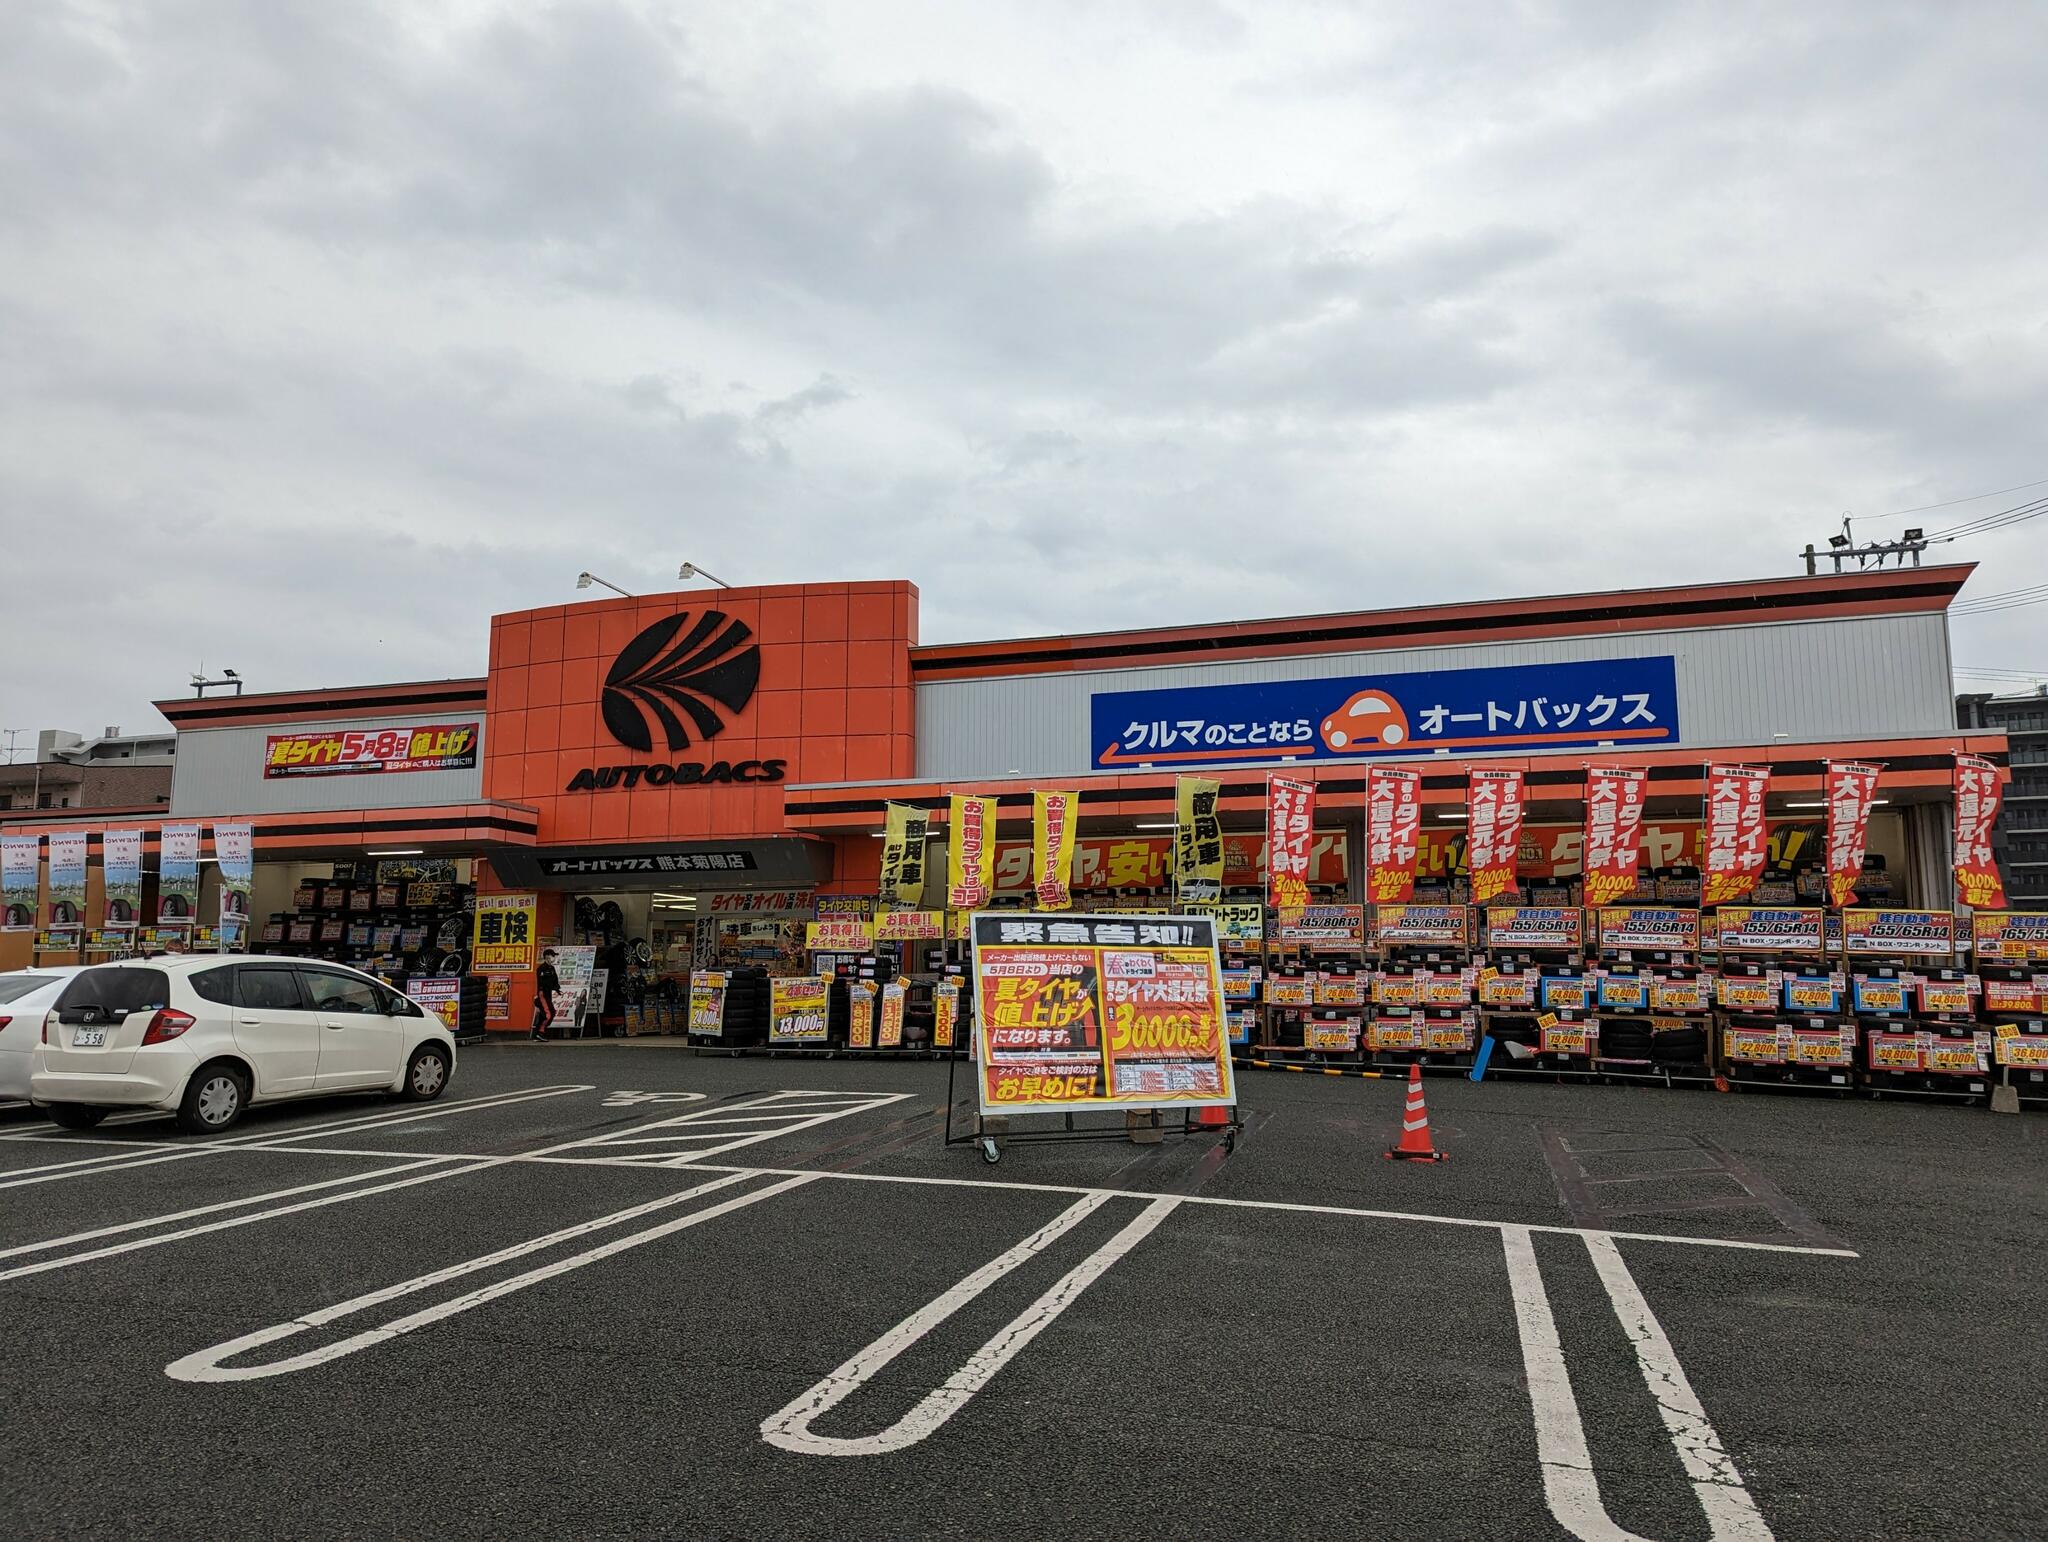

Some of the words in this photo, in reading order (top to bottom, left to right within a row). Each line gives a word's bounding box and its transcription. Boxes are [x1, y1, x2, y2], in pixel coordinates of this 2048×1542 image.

[1123, 720, 1313, 750] クルマのことなら
[1419, 692, 1656, 735] オートバックス
[271, 740, 341, 764] 夏タイヤ
[566, 760, 787, 791] AUTOBACS
[1193, 792, 1221, 865] 商用車
[552, 858, 653, 872] オートバックス
[656, 853, 746, 870] 熊本菊陽店
[900, 820, 926, 885] 商用車
[479, 911, 529, 944] 車検
[1299, 917, 1360, 927] 145/80R13
[1399, 918, 1462, 928] 155/65R13
[1509, 920, 1578, 931] 155/65R14
[1623, 921, 1695, 933] 155/65R14
[1742, 922, 1819, 934] 155/65R14
[1869, 924, 1950, 937] 155/65R14
[1001, 922, 1193, 945] 緊急告知!!
[476, 947, 531, 963] 見積り無料!
[990, 966, 1041, 974] 5月8日より
[1049, 964, 1083, 975] 当店の
[994, 978, 1088, 1001] 夏タイヤが
[779, 1014, 824, 1034] 13,000円
[994, 1002, 1077, 1026] 値上げ
[992, 1029, 1071, 1044] になります。
[996, 1076, 1096, 1100] お早めに!
